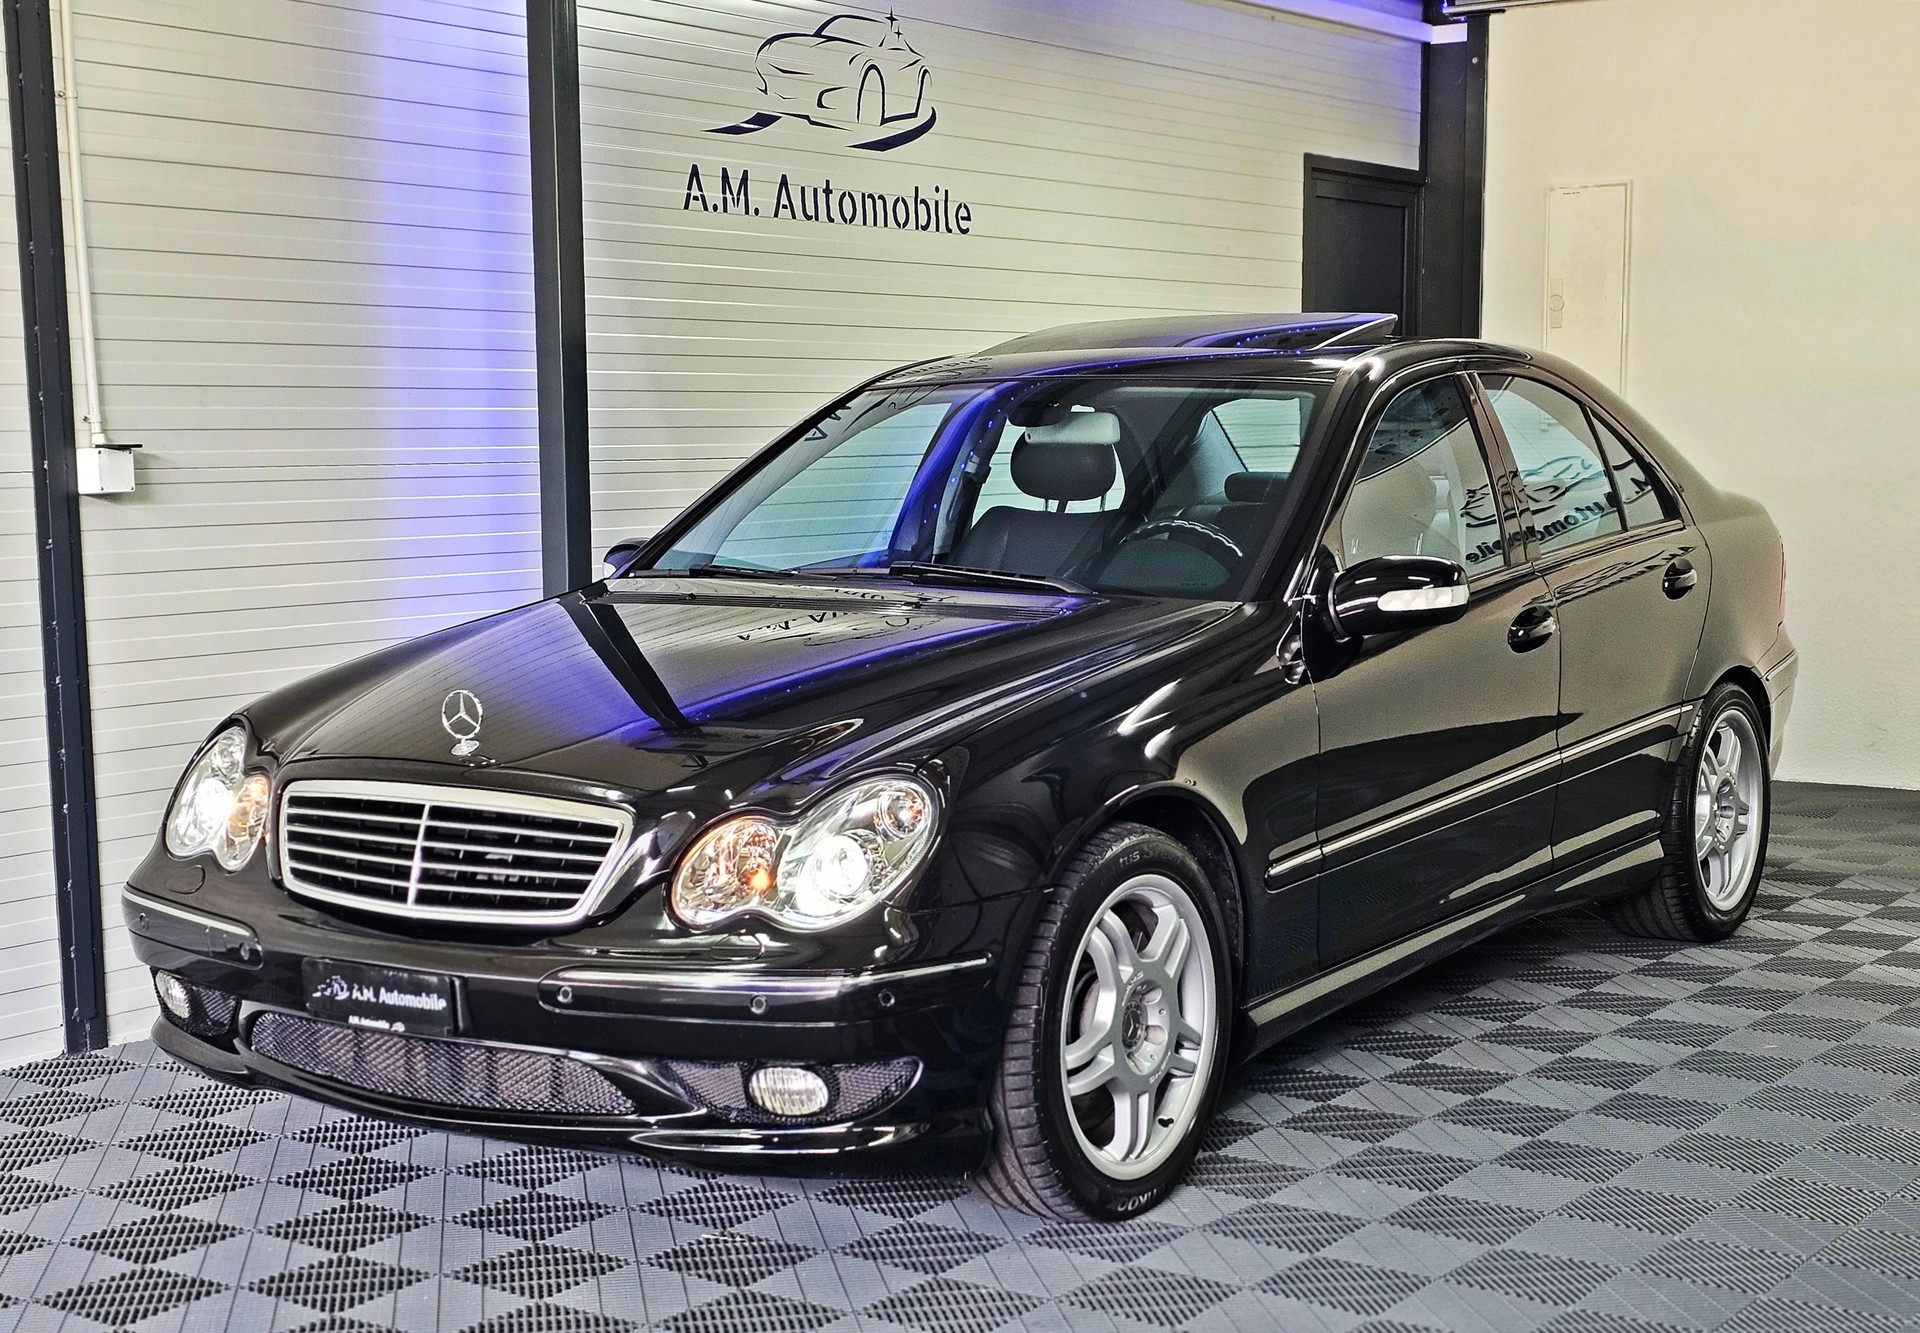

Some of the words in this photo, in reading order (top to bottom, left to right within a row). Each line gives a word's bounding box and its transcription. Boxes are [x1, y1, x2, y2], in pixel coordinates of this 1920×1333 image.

[683, 163, 760, 217] A.M.
[773, 173, 972, 235] Automobile
[379, 987, 447, 1010] Automobile
